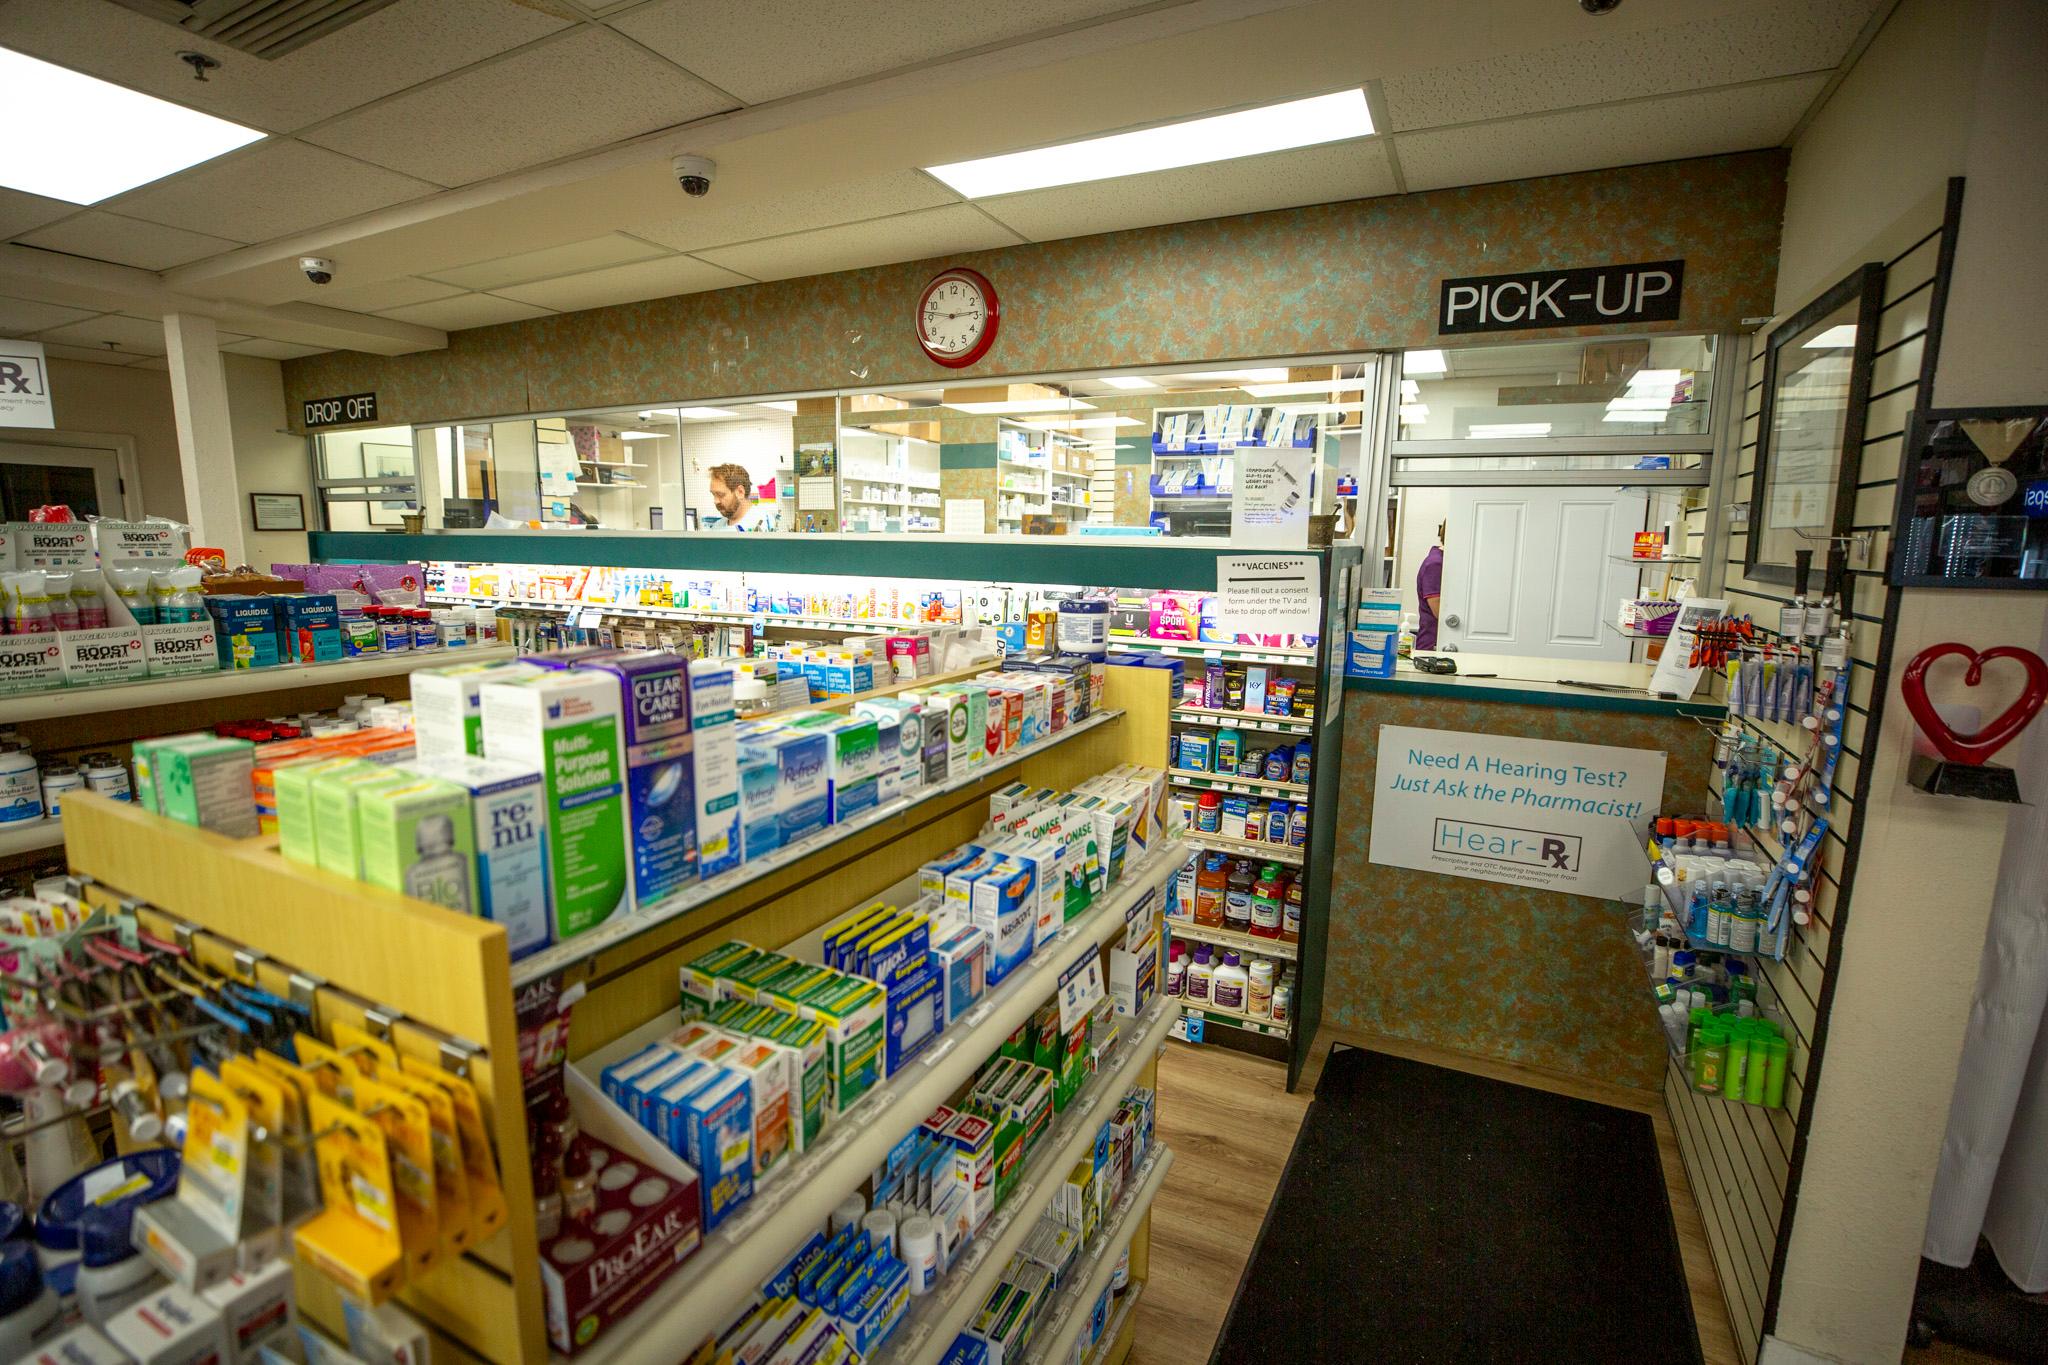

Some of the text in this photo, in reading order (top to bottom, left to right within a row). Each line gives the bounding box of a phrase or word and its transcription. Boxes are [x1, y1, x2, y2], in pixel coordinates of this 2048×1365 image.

[939, 291, 944, 300] 11
[950, 285, 958, 295] 12
[962, 288, 965, 297] 1
[1447, 271, 1673, 325] PICK-UP
[930, 301, 938, 310] 10
[970, 298, 975, 306] 2
[928, 315, 934, 323] 9
[973, 311, 979, 320] 3
[931, 327, 937, 336] 8
[969, 324, 975, 333] 4
[940, 336, 945, 345] 7
[949, 339, 955, 348] 6
[961, 335, 967, 343] 5
[305, 397, 374, 424] DROP OFF
[33, 535, 75, 547] BOOST
[122, 533, 160, 541] BOOST
[235, 609, 260, 617] LIQUID
[301, 606, 326, 614] LIQUID
[1160, 616, 1184, 626] SPORT
[77, 645, 129, 661] BOOST
[154, 638, 203, 654] BOOST
[0, 651, 47, 668] OOST
[635, 676, 681, 699] CLEAR
[640, 694, 680, 716] CARE
[553, 735, 593, 755] Multi-
[555, 749, 609, 775] Purpose
[1408, 749, 1628, 789] Need A Hearing Test?
[784, 759, 823, 784] Refresh
[557, 767, 611, 794] Solution
[1390, 773, 1643, 819] Just Ask the Pharmacist!
[492, 802, 533, 828] re-
[494, 822, 534, 848] nu
[1442, 823, 1569, 871] Hear-Rx
[1432, 855, 1468, 866] Prescriptive
[1484, 862, 1498, 870] OTC
[1499, 864, 1524, 875] hearing
[1525, 868, 1559, 879] treatment
[1470, 867, 1516, 879] neighborhood
[1517, 874, 1551, 884] pharmacy
